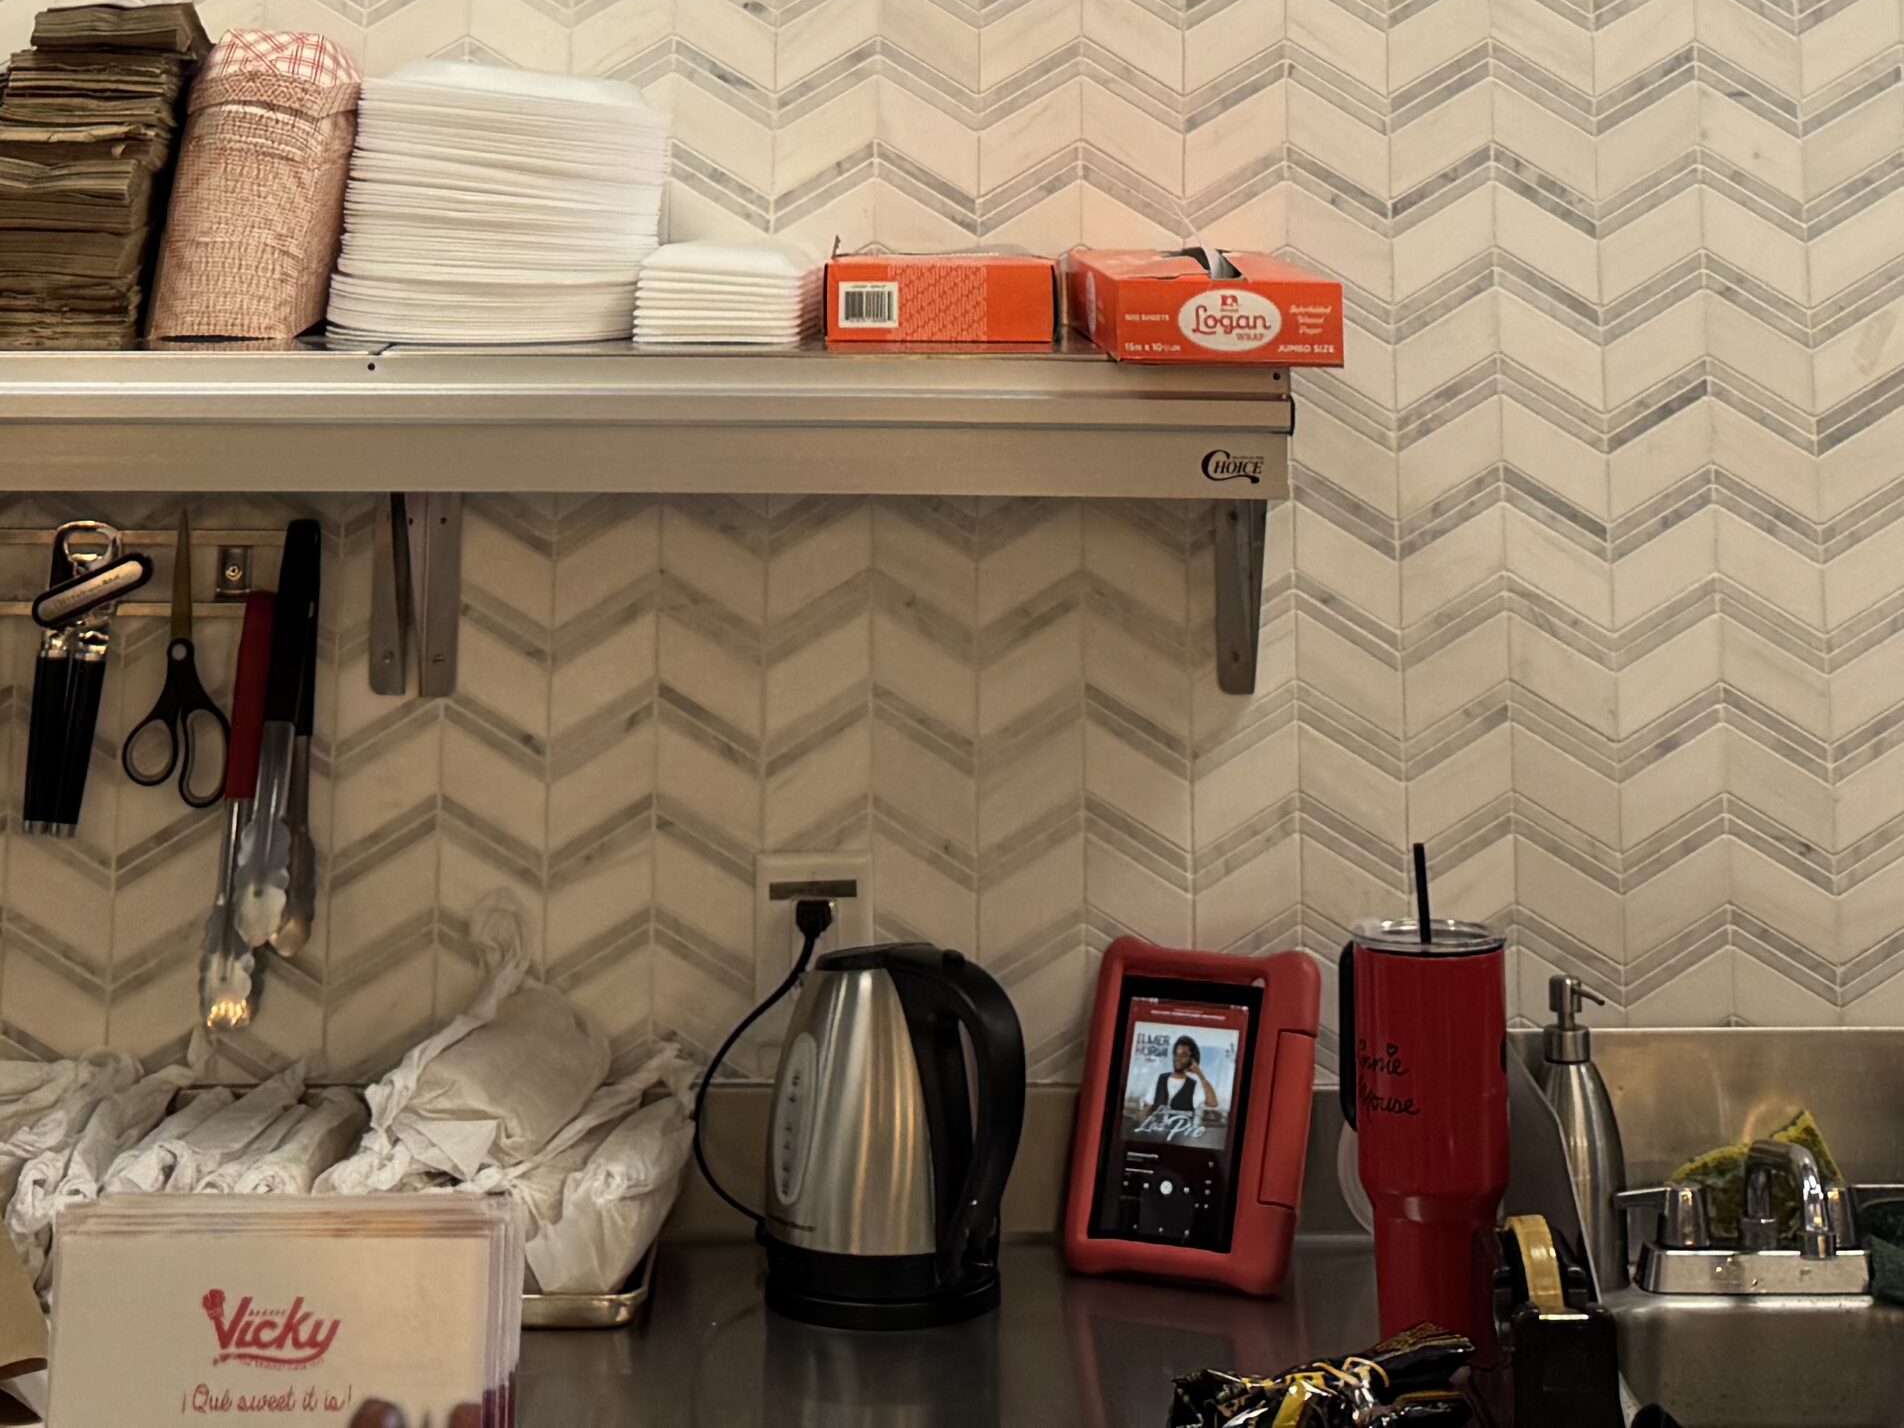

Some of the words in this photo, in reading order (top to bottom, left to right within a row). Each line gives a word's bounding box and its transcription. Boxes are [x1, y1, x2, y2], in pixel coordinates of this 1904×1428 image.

[1192, 305, 1271, 335] Logan
[1201, 450, 1264, 484] CHOICE
[202, 1289, 341, 1366] Vicky
